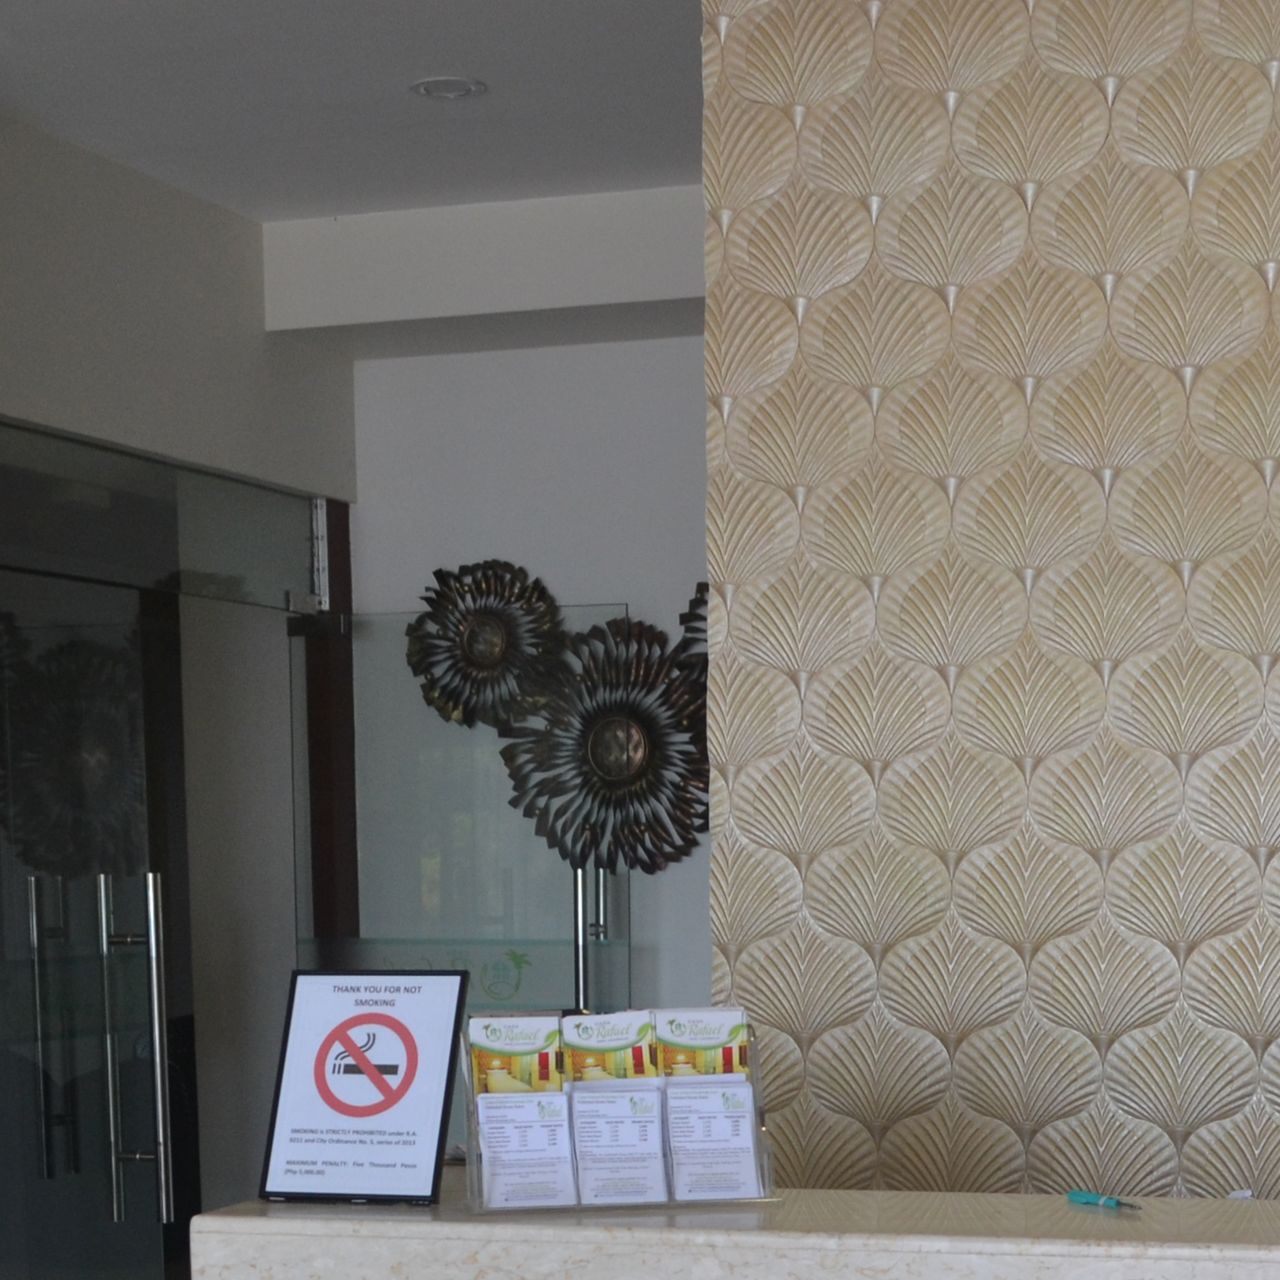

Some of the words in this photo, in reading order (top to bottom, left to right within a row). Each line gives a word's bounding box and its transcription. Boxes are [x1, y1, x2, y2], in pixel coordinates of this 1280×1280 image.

[332, 985, 361, 993] THANK
[363, 985, 382, 993] YOU
[384, 985, 401, 993] FOR
[403, 986, 423, 994] NOT
[353, 998, 396, 1007] SMOKING
